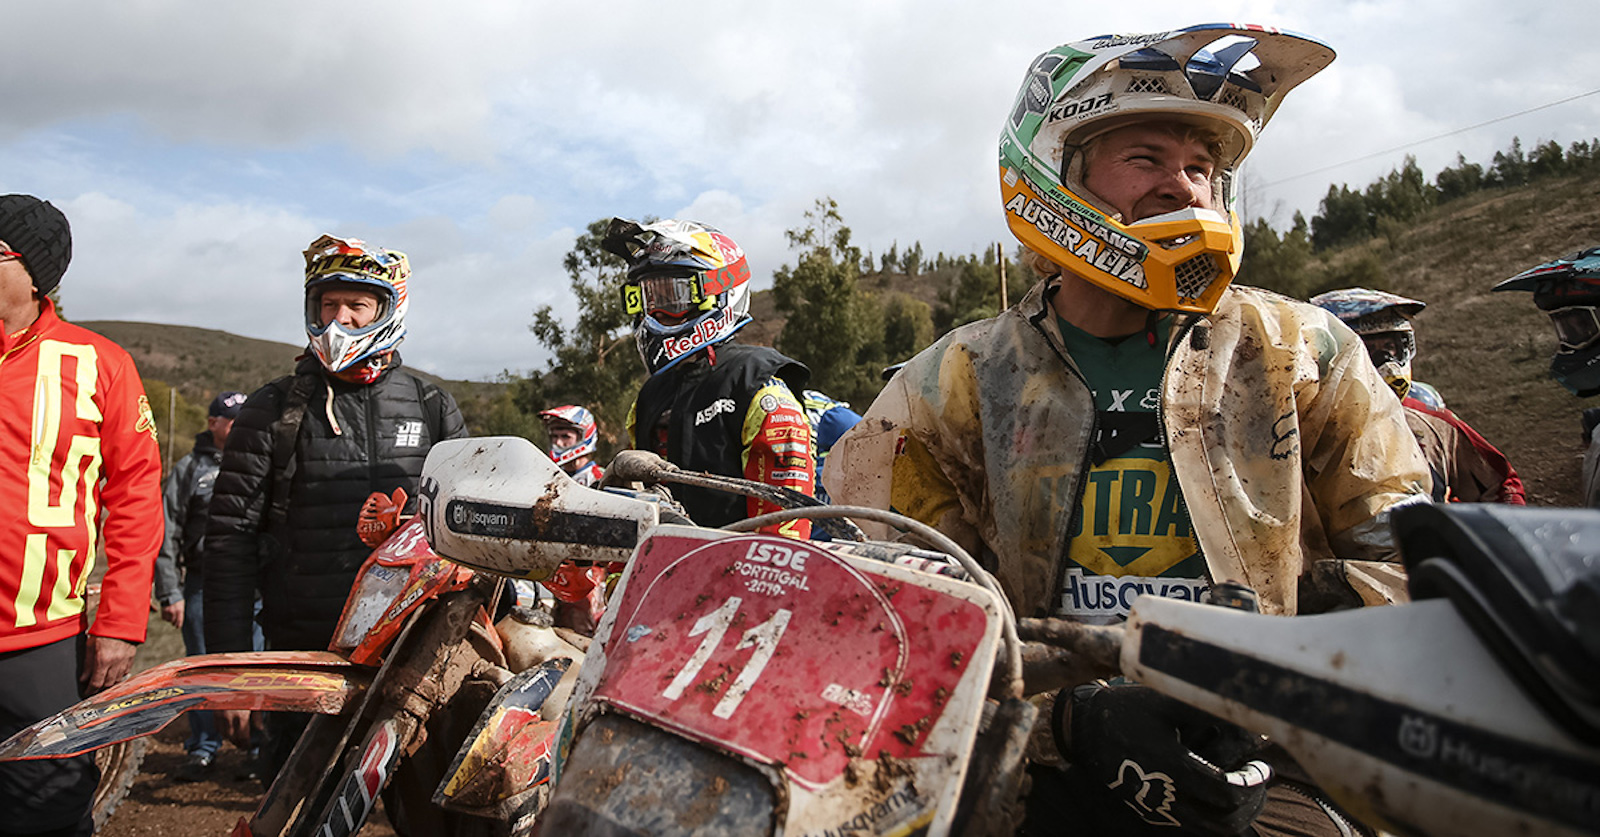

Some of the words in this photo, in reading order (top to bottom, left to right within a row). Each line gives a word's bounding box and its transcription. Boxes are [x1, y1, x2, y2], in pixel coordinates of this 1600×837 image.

[1048, 187, 1106, 222] MELBOURNE
[1005, 192, 1149, 290] AUSTRALIA
[664, 324, 704, 361] Red
[703, 306, 734, 340] Bull
[745, 541, 811, 573] ISDE
[661, 595, 793, 720] 11
